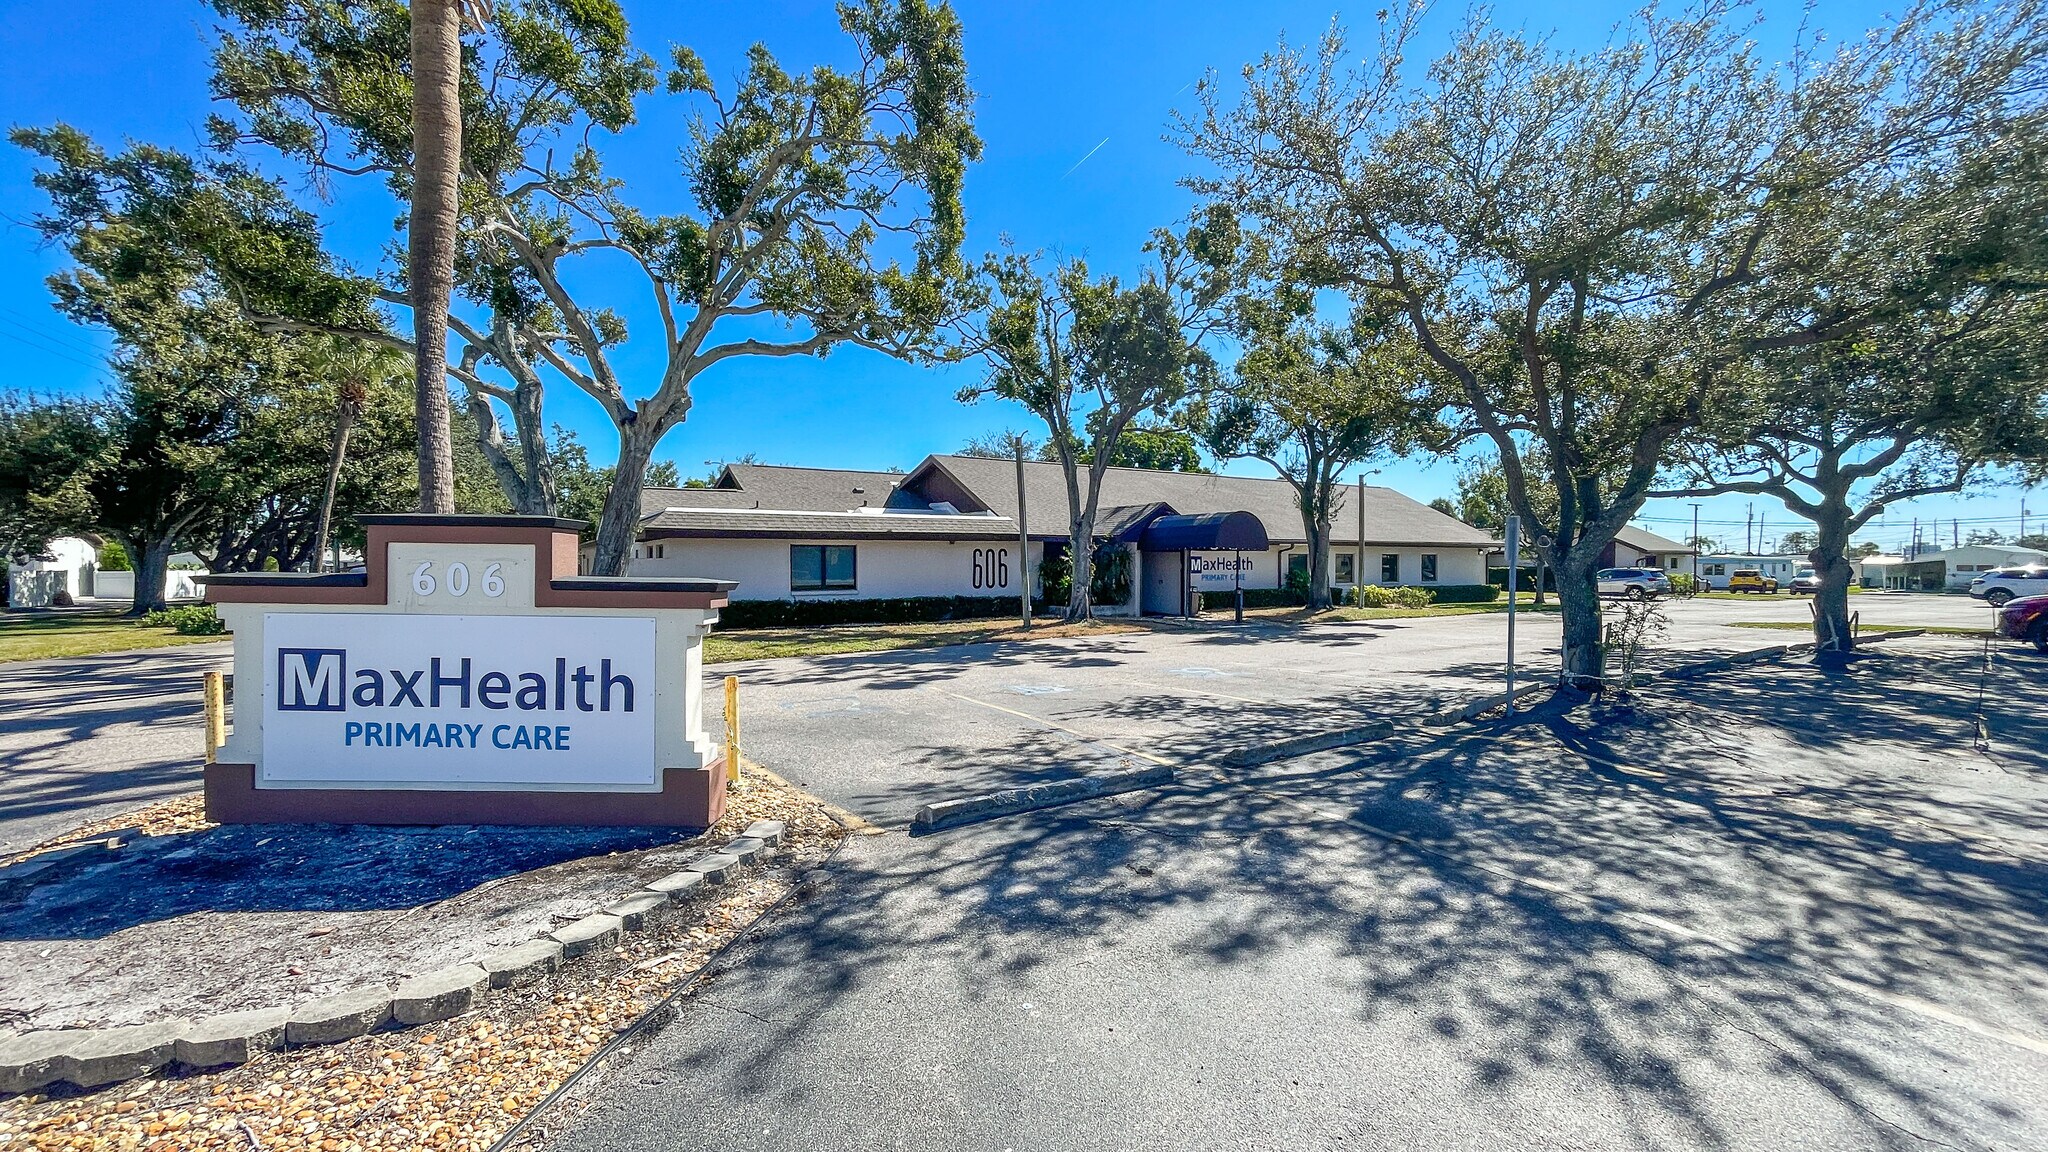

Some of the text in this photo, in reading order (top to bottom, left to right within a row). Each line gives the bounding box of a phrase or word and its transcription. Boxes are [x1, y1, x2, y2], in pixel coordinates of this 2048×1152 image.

[412, 561, 506, 598] 606
[972, 548, 1008, 589] 606
[1190, 556, 1253, 573] MaxHealth
[1201, 573, 1228, 581] PRIMARY
[277, 647, 635, 712] MaxHealth
[344, 721, 571, 750] PRIMARY CARE
